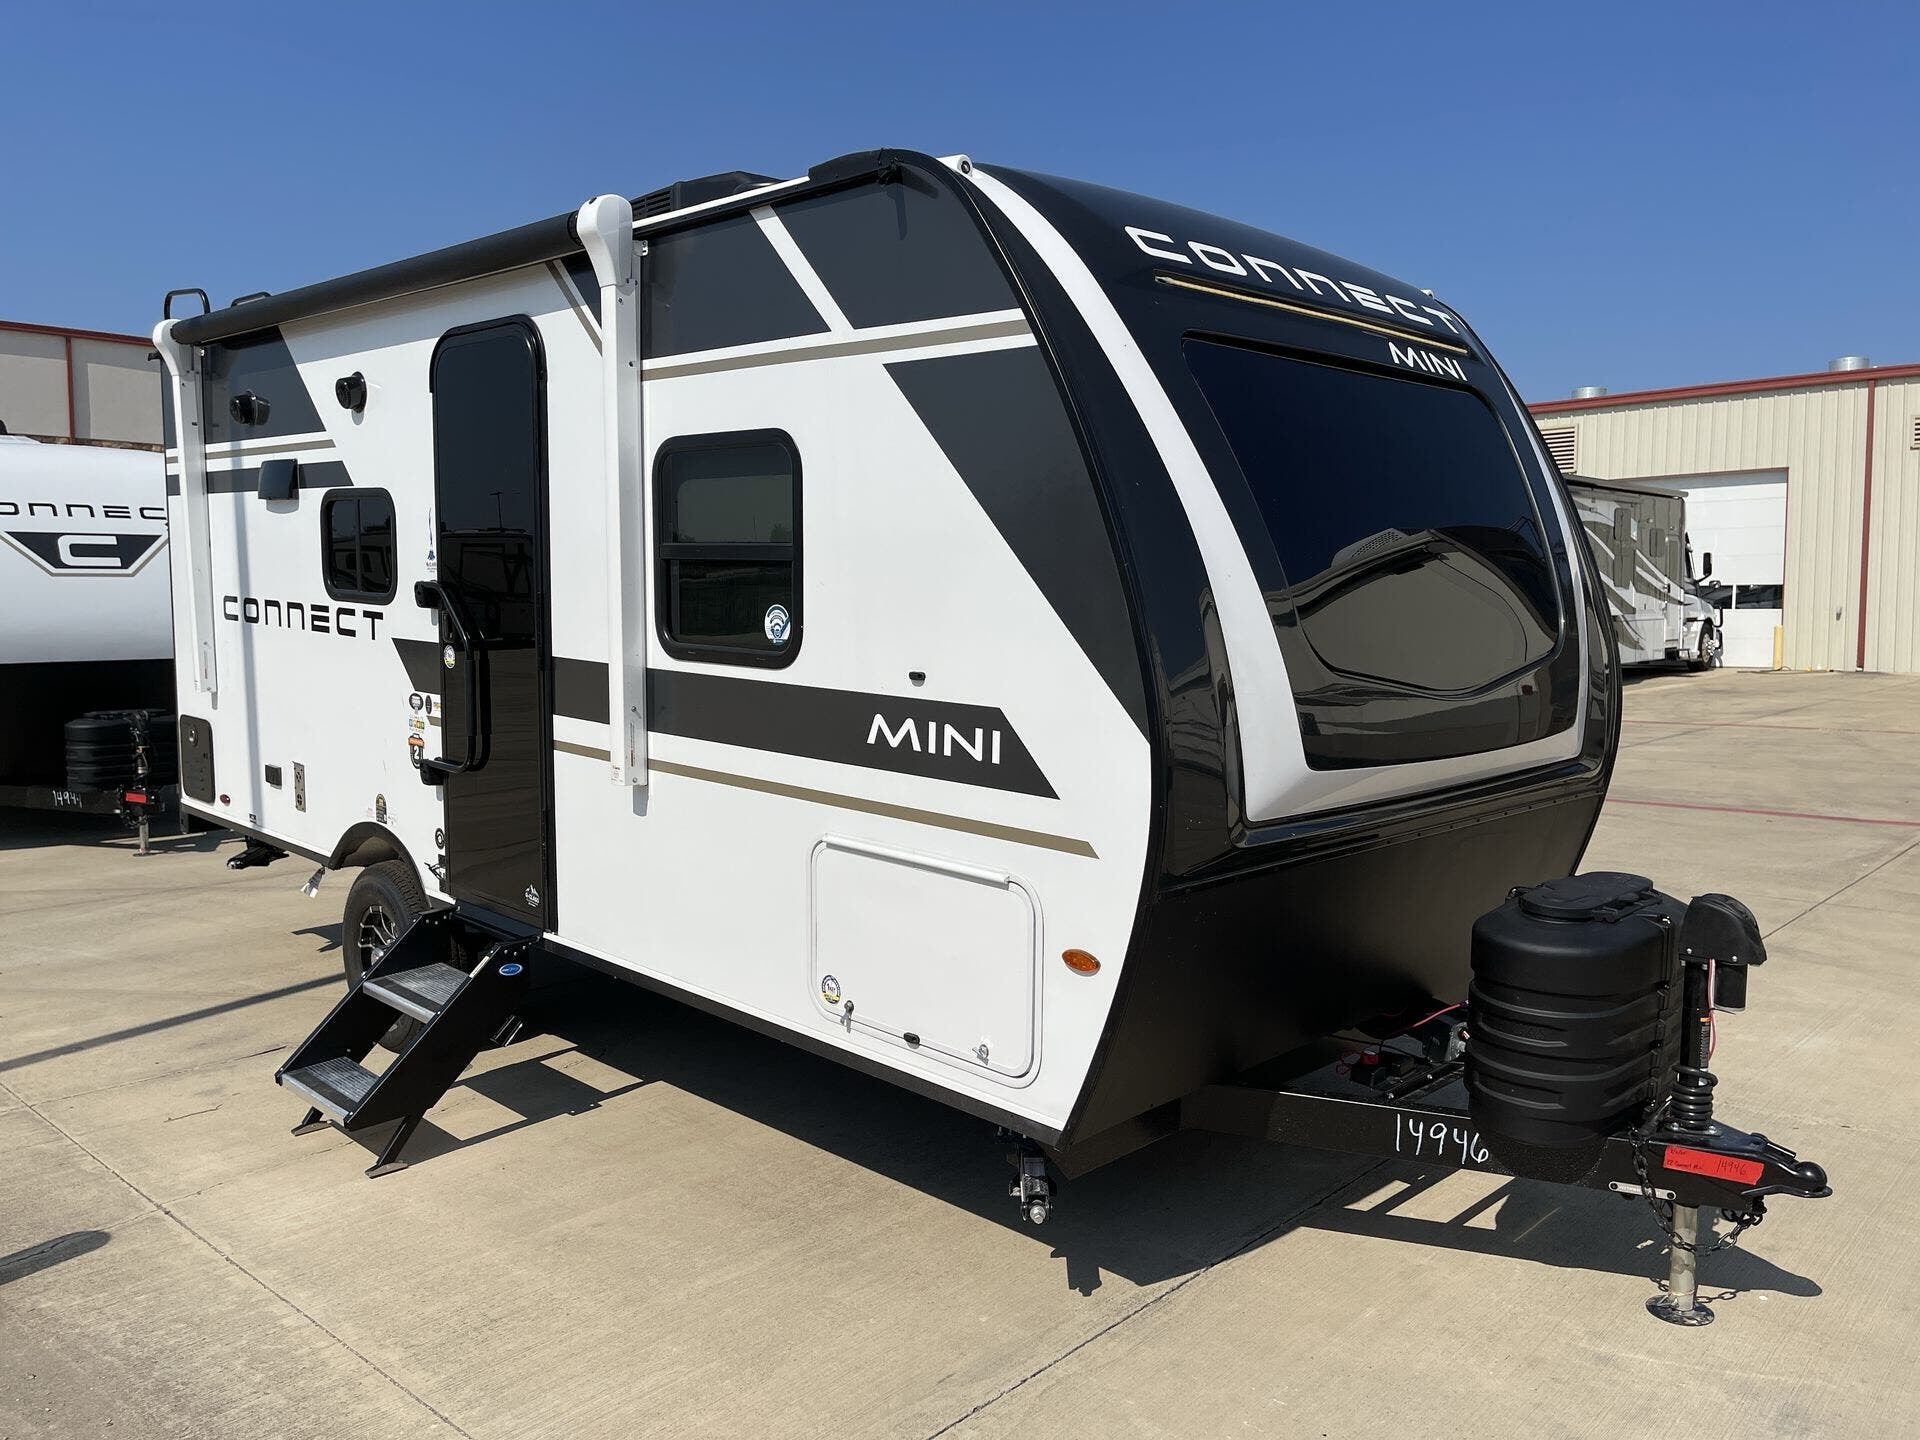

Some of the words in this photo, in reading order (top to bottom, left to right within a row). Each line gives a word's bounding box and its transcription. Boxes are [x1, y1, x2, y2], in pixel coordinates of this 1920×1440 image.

[1124, 225, 1459, 334] CONNECT
[1388, 341, 1467, 381] MINI
[223, 595, 384, 641] CONNECT
[866, 713, 1001, 765] MINI
[1396, 1113, 1490, 1165] 14946
[1716, 1160, 1748, 1176] 14946
